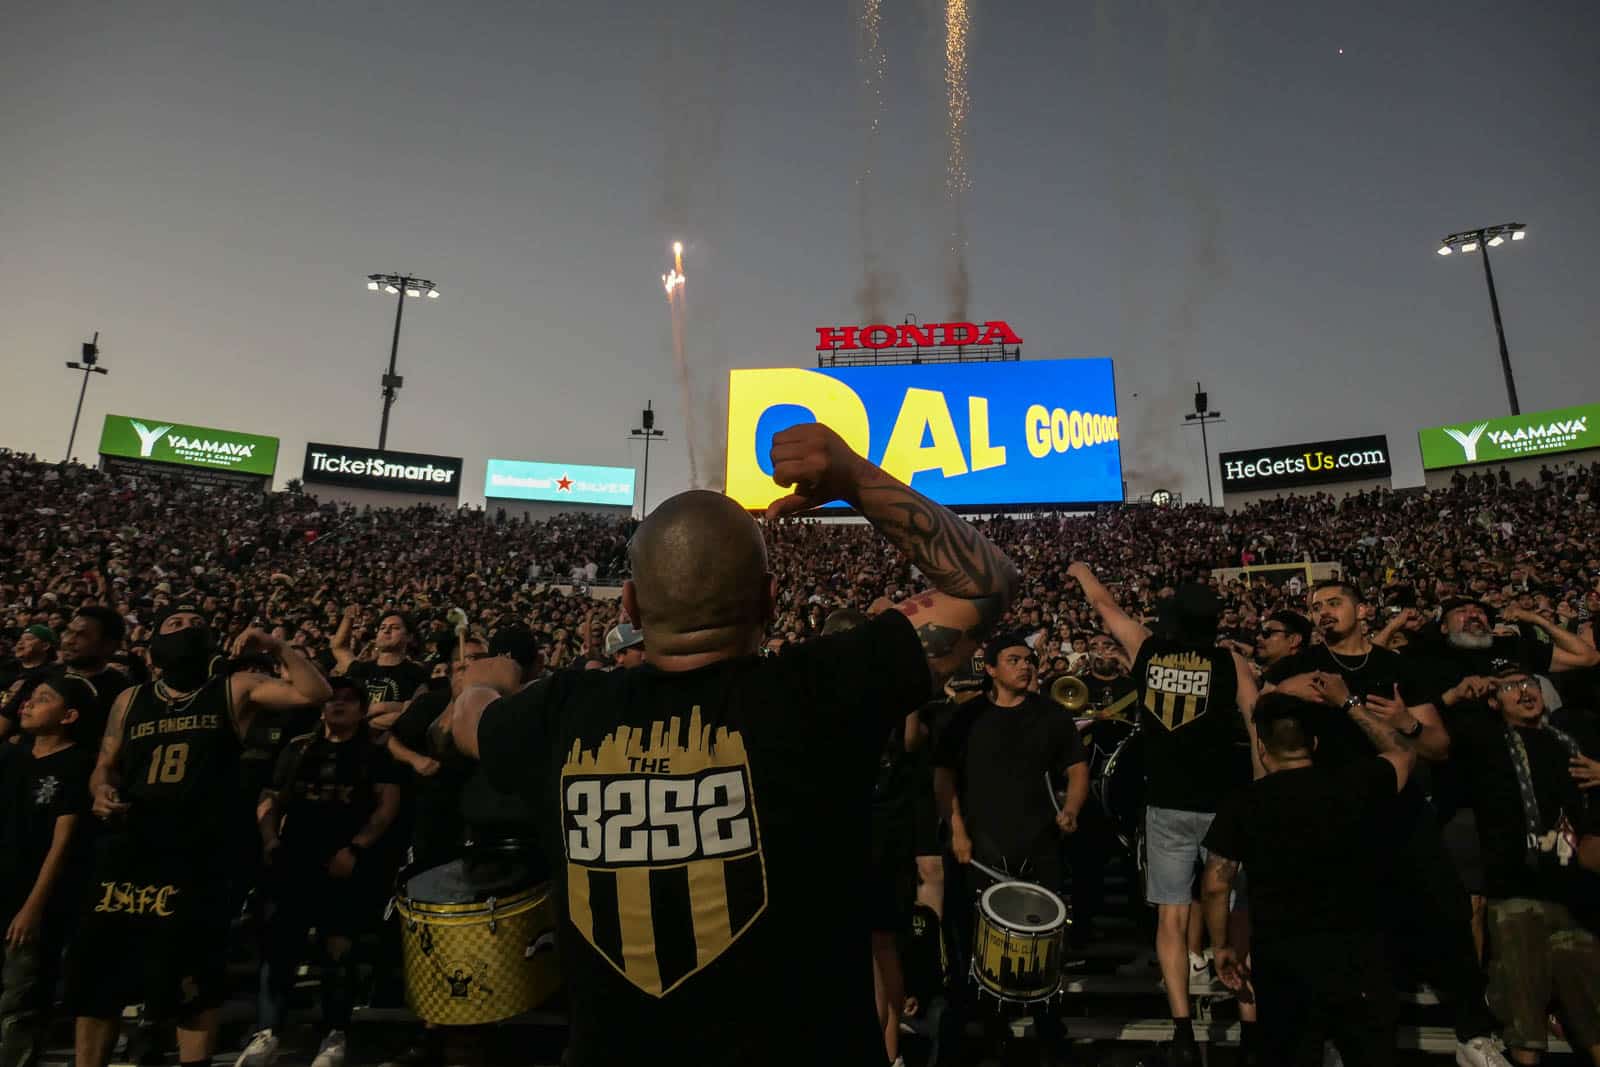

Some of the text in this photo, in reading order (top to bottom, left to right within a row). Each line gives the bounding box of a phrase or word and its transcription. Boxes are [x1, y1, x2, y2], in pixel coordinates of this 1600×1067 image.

[816, 320, 1023, 350] HONDA
[311, 453, 455, 483] TicketSmarter
[1225, 450, 1386, 480] HeGetsUs.com
[1148, 665, 1209, 696] 3252
[129, 714, 219, 740] LOS ANGELES
[146, 742, 190, 785] 18
[627, 756, 671, 774] THE
[567, 770, 752, 863] 3252
